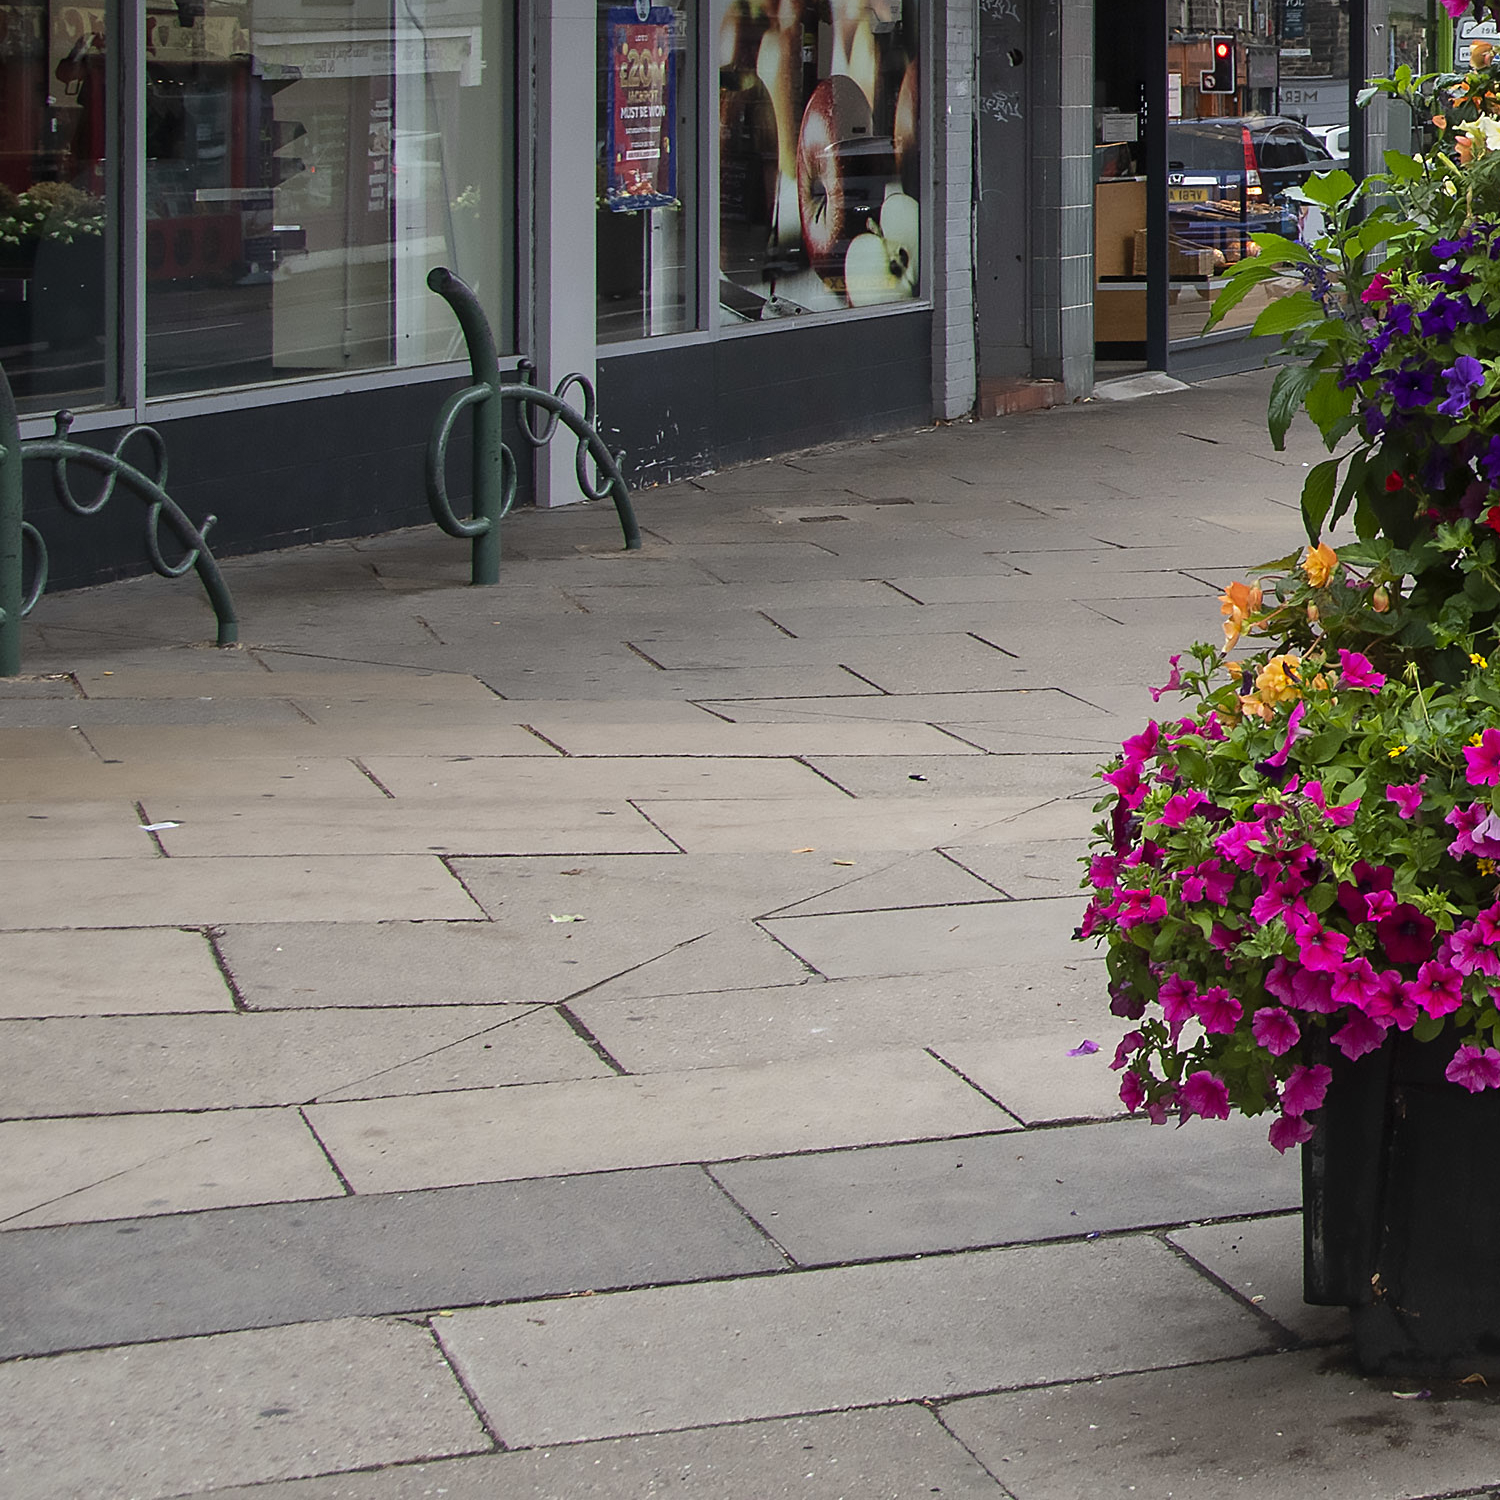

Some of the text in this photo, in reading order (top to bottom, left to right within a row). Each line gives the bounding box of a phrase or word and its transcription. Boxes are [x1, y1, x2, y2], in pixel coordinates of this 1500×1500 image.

[620, 104, 666, 119] MUST BE WON
